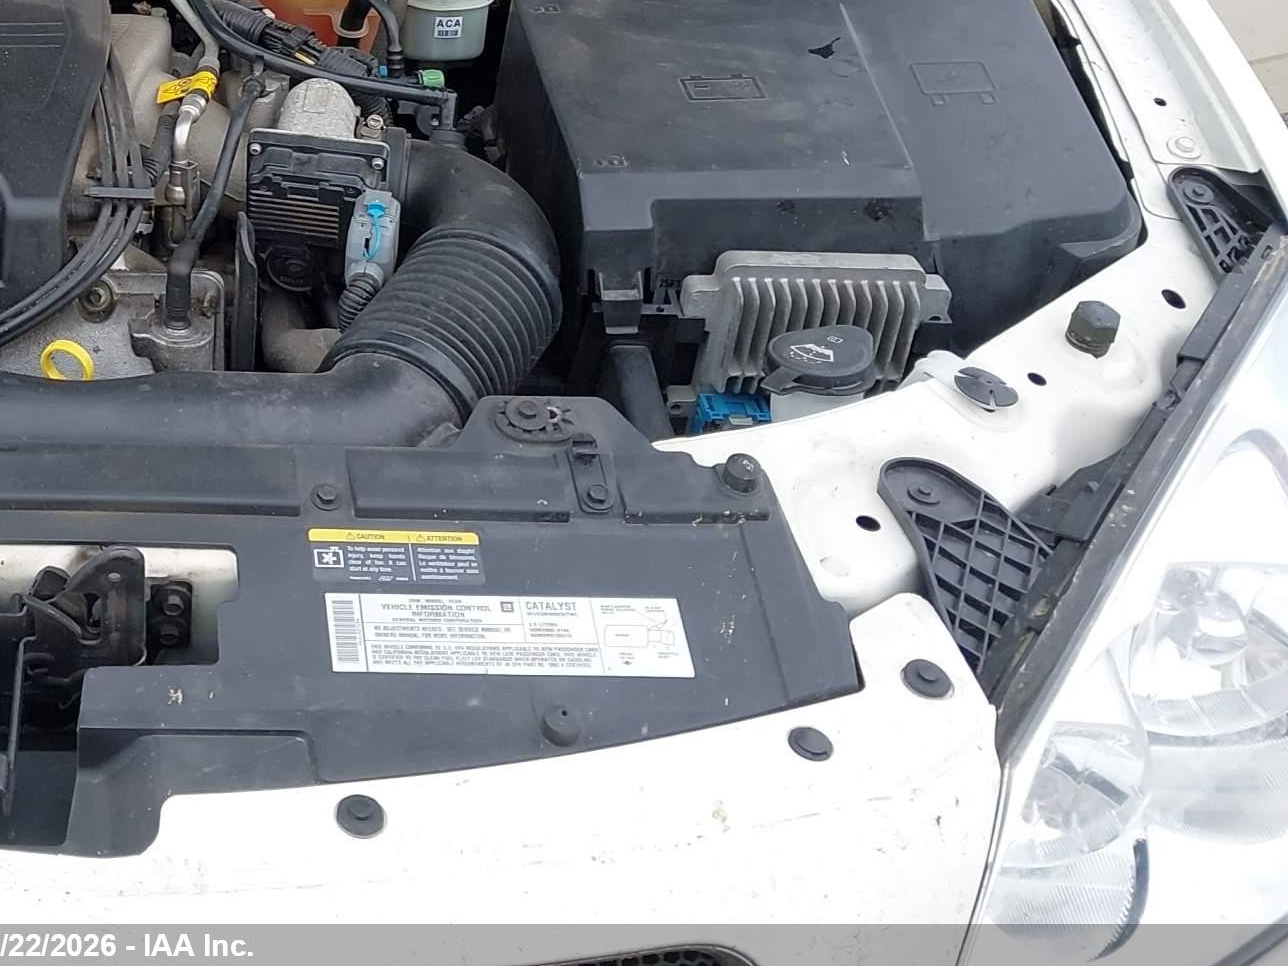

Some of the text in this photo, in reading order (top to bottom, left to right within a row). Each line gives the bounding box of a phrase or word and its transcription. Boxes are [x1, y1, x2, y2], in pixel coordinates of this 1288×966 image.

[436, 18, 461, 28] ACA
[380, 603, 413, 611] VEHICLE
[525, 601, 577, 611] CATALYST
